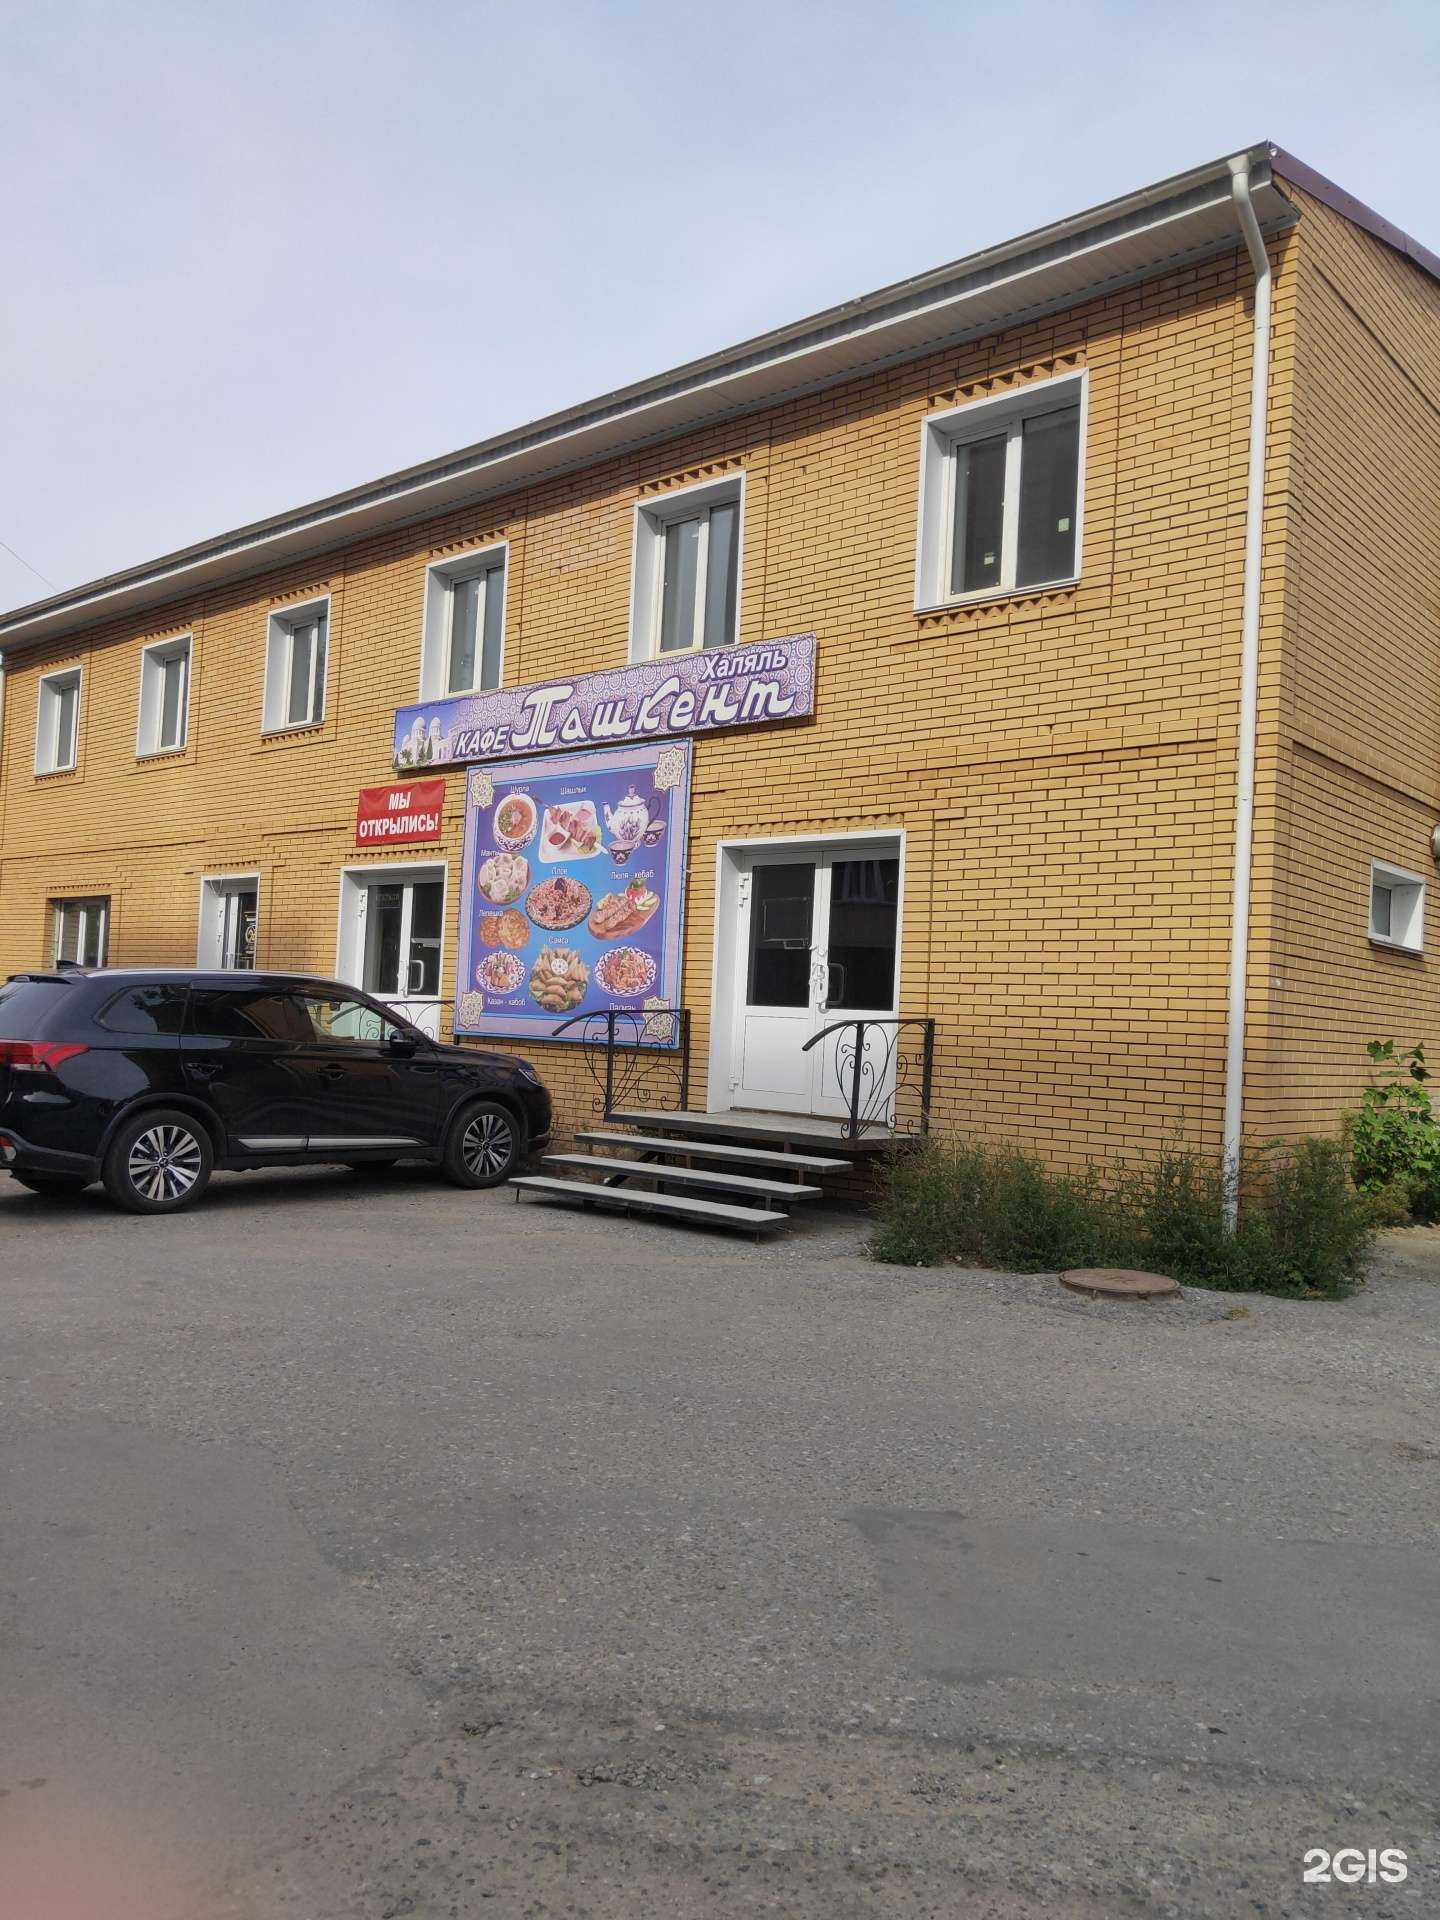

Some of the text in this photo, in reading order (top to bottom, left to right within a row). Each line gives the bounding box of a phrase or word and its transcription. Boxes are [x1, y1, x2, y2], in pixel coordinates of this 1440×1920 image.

[702, 650, 786, 680] Халяль
[456, 679, 795, 755] КАФЕ Ташкент
[389, 792, 411, 810] МЫ
[360, 813, 439, 838] ОТКРЫЛИСЬ!
